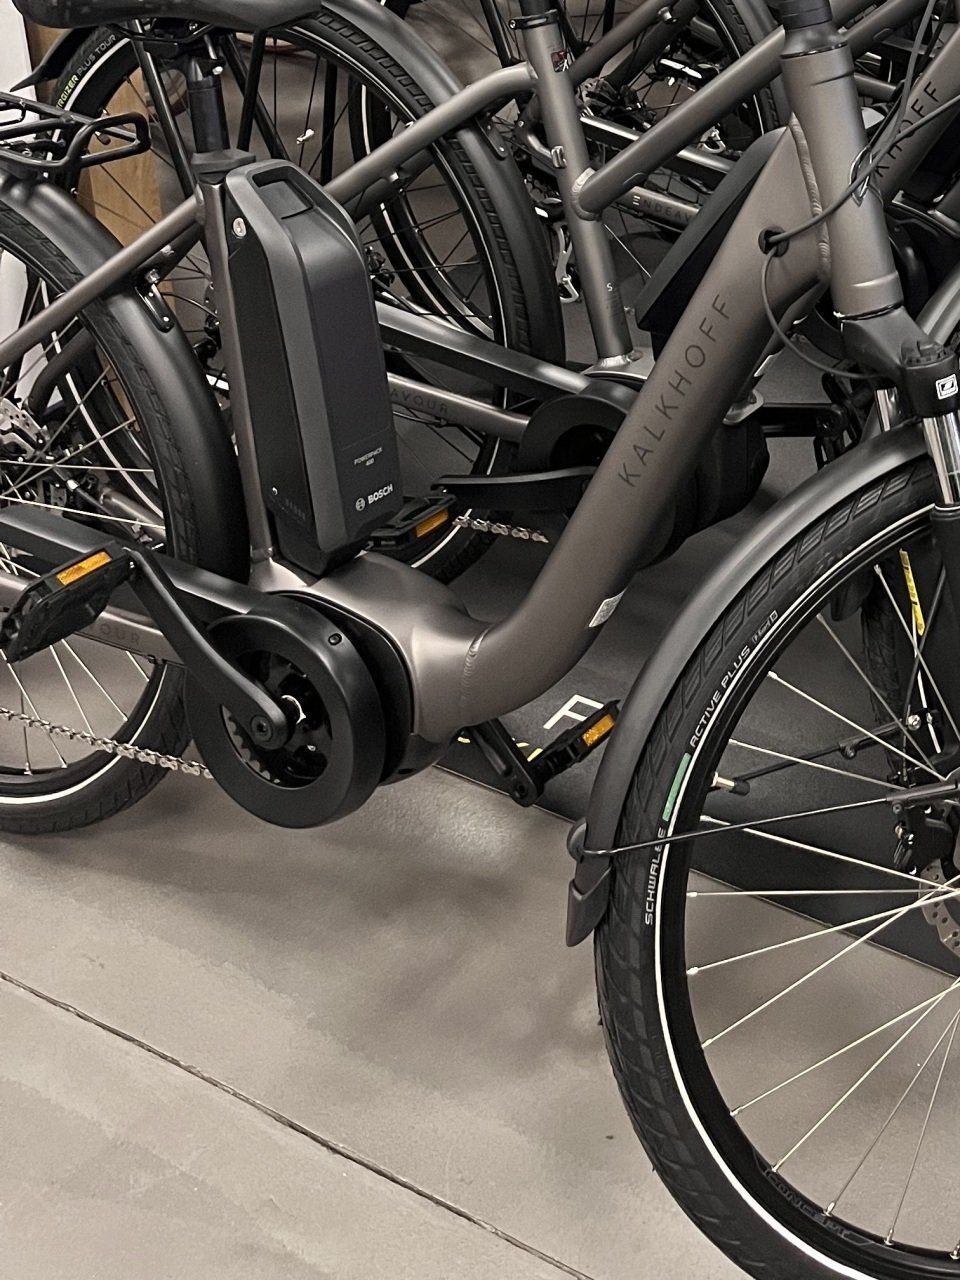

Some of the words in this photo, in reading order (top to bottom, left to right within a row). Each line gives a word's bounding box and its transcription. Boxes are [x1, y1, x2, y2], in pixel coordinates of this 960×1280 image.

[95, 34, 117, 54] TOUR
[617, 293, 730, 488] KALKHOFF
[367, 483, 394, 505] BOSCH
[688, 690, 722, 749] ACTIVE
[720, 645, 752, 690] PLUS
[644, 826, 666, 926] SCHWALBE
